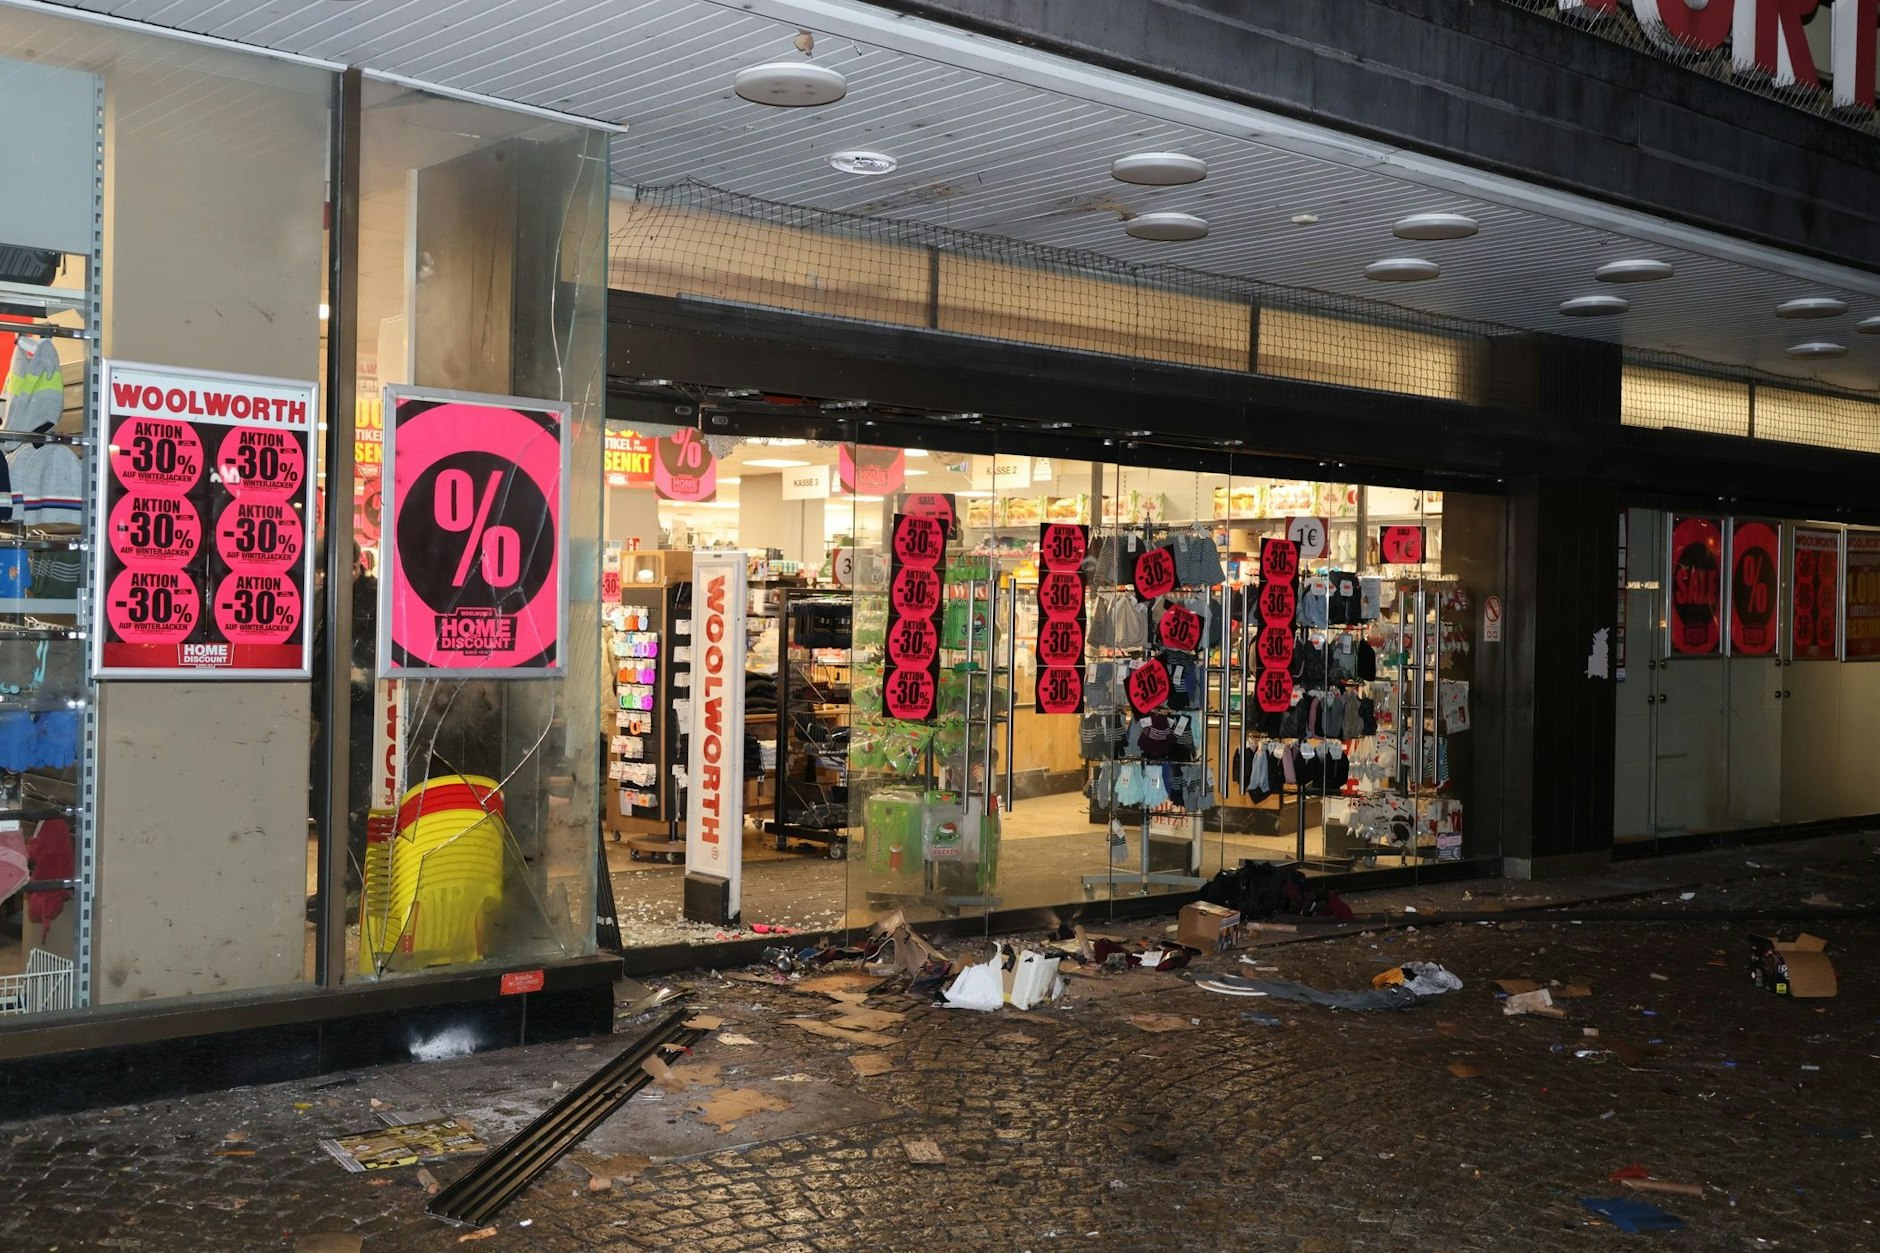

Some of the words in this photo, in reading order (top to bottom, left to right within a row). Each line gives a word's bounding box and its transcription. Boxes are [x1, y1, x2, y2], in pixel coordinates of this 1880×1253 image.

[112, 383, 305, 424] WOOLWORTH
[135, 422, 182, 439] AKTION
[240, 431, 283, 447] AKTION
[120, 437, 196, 474] -30%
[225, 446, 297, 482] -30%
[123, 471, 136, 479] AUF
[794, 479, 812, 488] KASSE
[133, 498, 180, 513] AKTION
[238, 504, 282, 519] AKTION
[117, 512, 193, 549] -30%
[433, 468, 521, 588] %
[908, 520, 932, 530] AKTION
[223, 518, 296, 554] -30%
[900, 529, 938, 554] -30%
[1297, 528, 1317, 547] 1€
[120, 546, 134, 554] AUF
[1047, 536, 1082, 559] -30%
[1392, 540, 1416, 558] 1€
[1266, 550, 1294, 570] -30%
[131, 573, 178, 588] AKTION
[236, 576, 280, 591] AKTION
[906, 570, 930, 580] AKTION
[1139, 561, 1172, 586] -30%
[897, 580, 936, 604] -30%
[1675, 566, 1718, 605] SALE
[1743, 554, 1768, 614] %
[115, 587, 192, 623] -30%
[1044, 584, 1078, 606] -30%
[1263, 593, 1292, 613] -30%
[222, 590, 294, 625] -30%
[119, 622, 132, 630] AUF
[442, 618, 510, 638] HOME
[902, 620, 926, 630] AKTION
[1165, 616, 1194, 646] -30%
[184, 644, 228, 656] HOME
[442, 638, 510, 648] DISCOUNT
[894, 630, 932, 654] -30%
[1044, 630, 1078, 653] -30%
[1262, 636, 1290, 656] -30%
[899, 671, 924, 682] AKTION
[1134, 673, 1166, 700] -30%
[890, 681, 930, 704] -30%
[1043, 678, 1078, 701] -30%
[1260, 680, 1290, 700] -30%
[700, 574, 726, 845] WOOLWORTH
